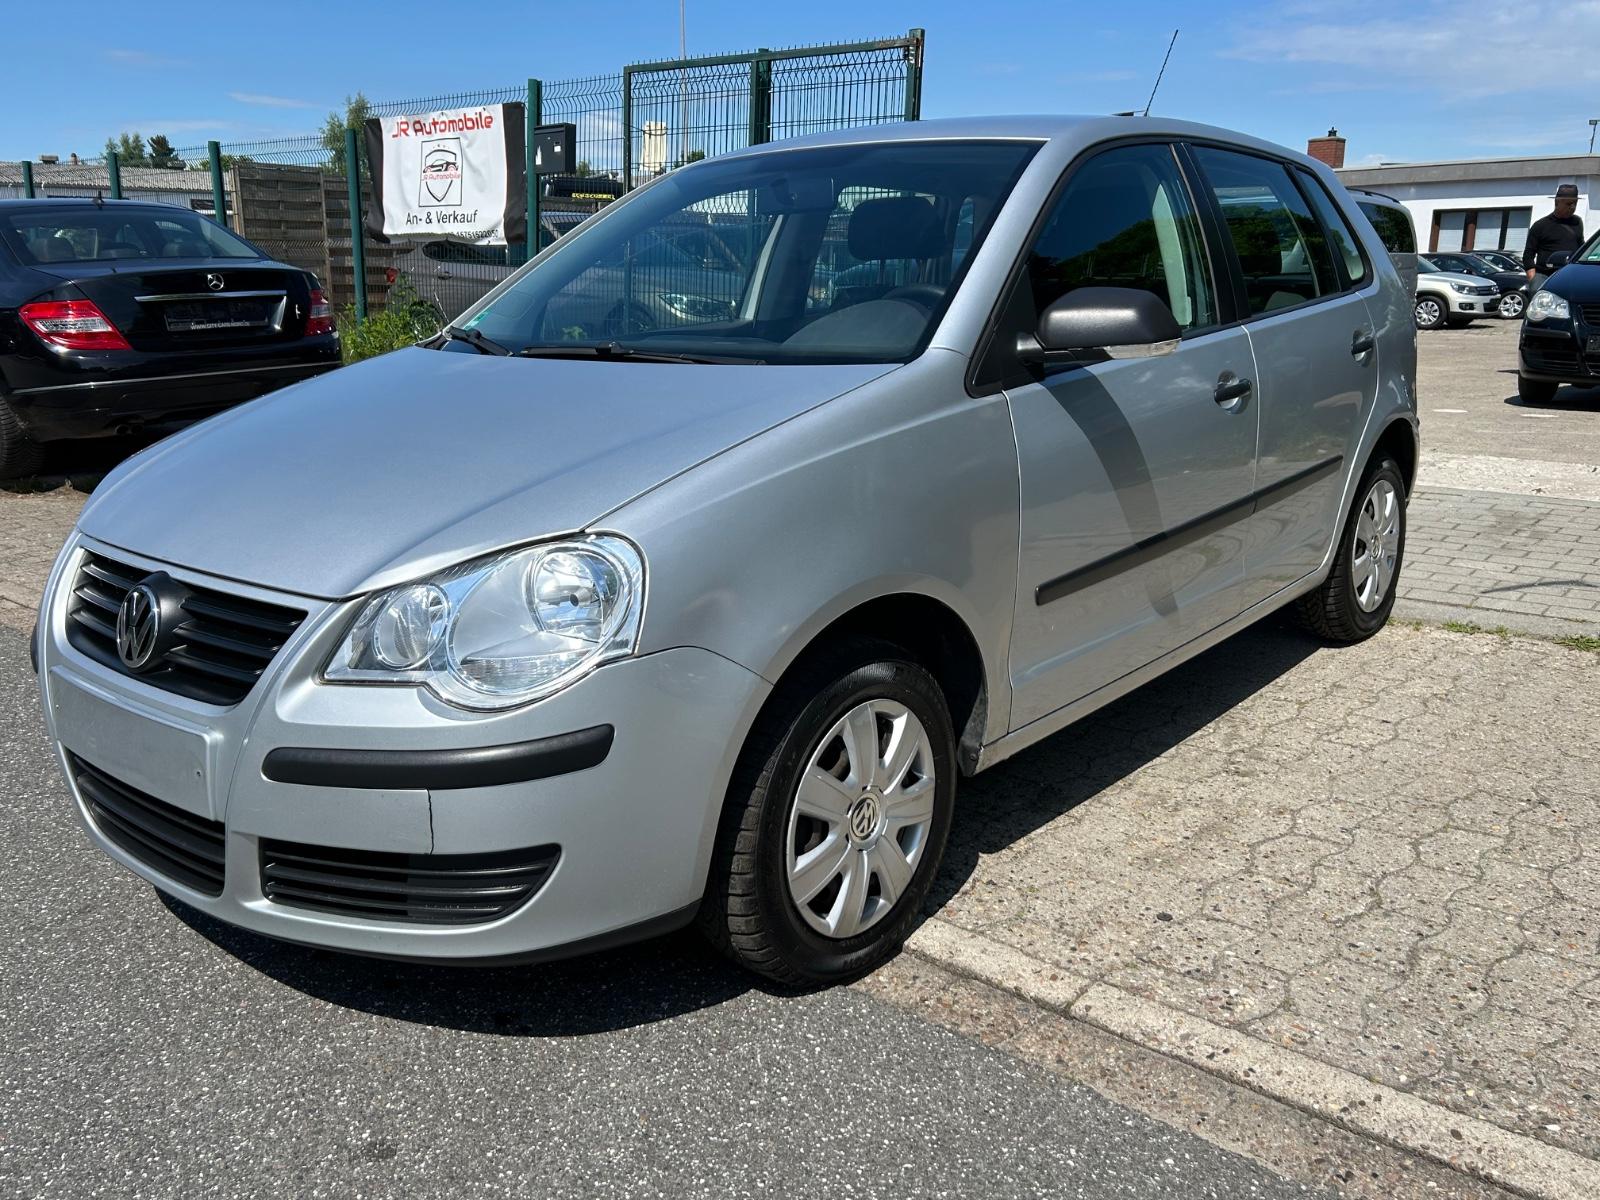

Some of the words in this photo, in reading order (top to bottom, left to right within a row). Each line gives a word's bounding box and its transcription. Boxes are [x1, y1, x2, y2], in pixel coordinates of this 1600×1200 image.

[392, 120, 410, 138] JR
[412, 111, 494, 137] Automobile
[429, 171, 461, 180] Automobile
[405, 212, 423, 226] An-
[425, 211, 433, 225] &
[435, 209, 479, 224] Verkauf
